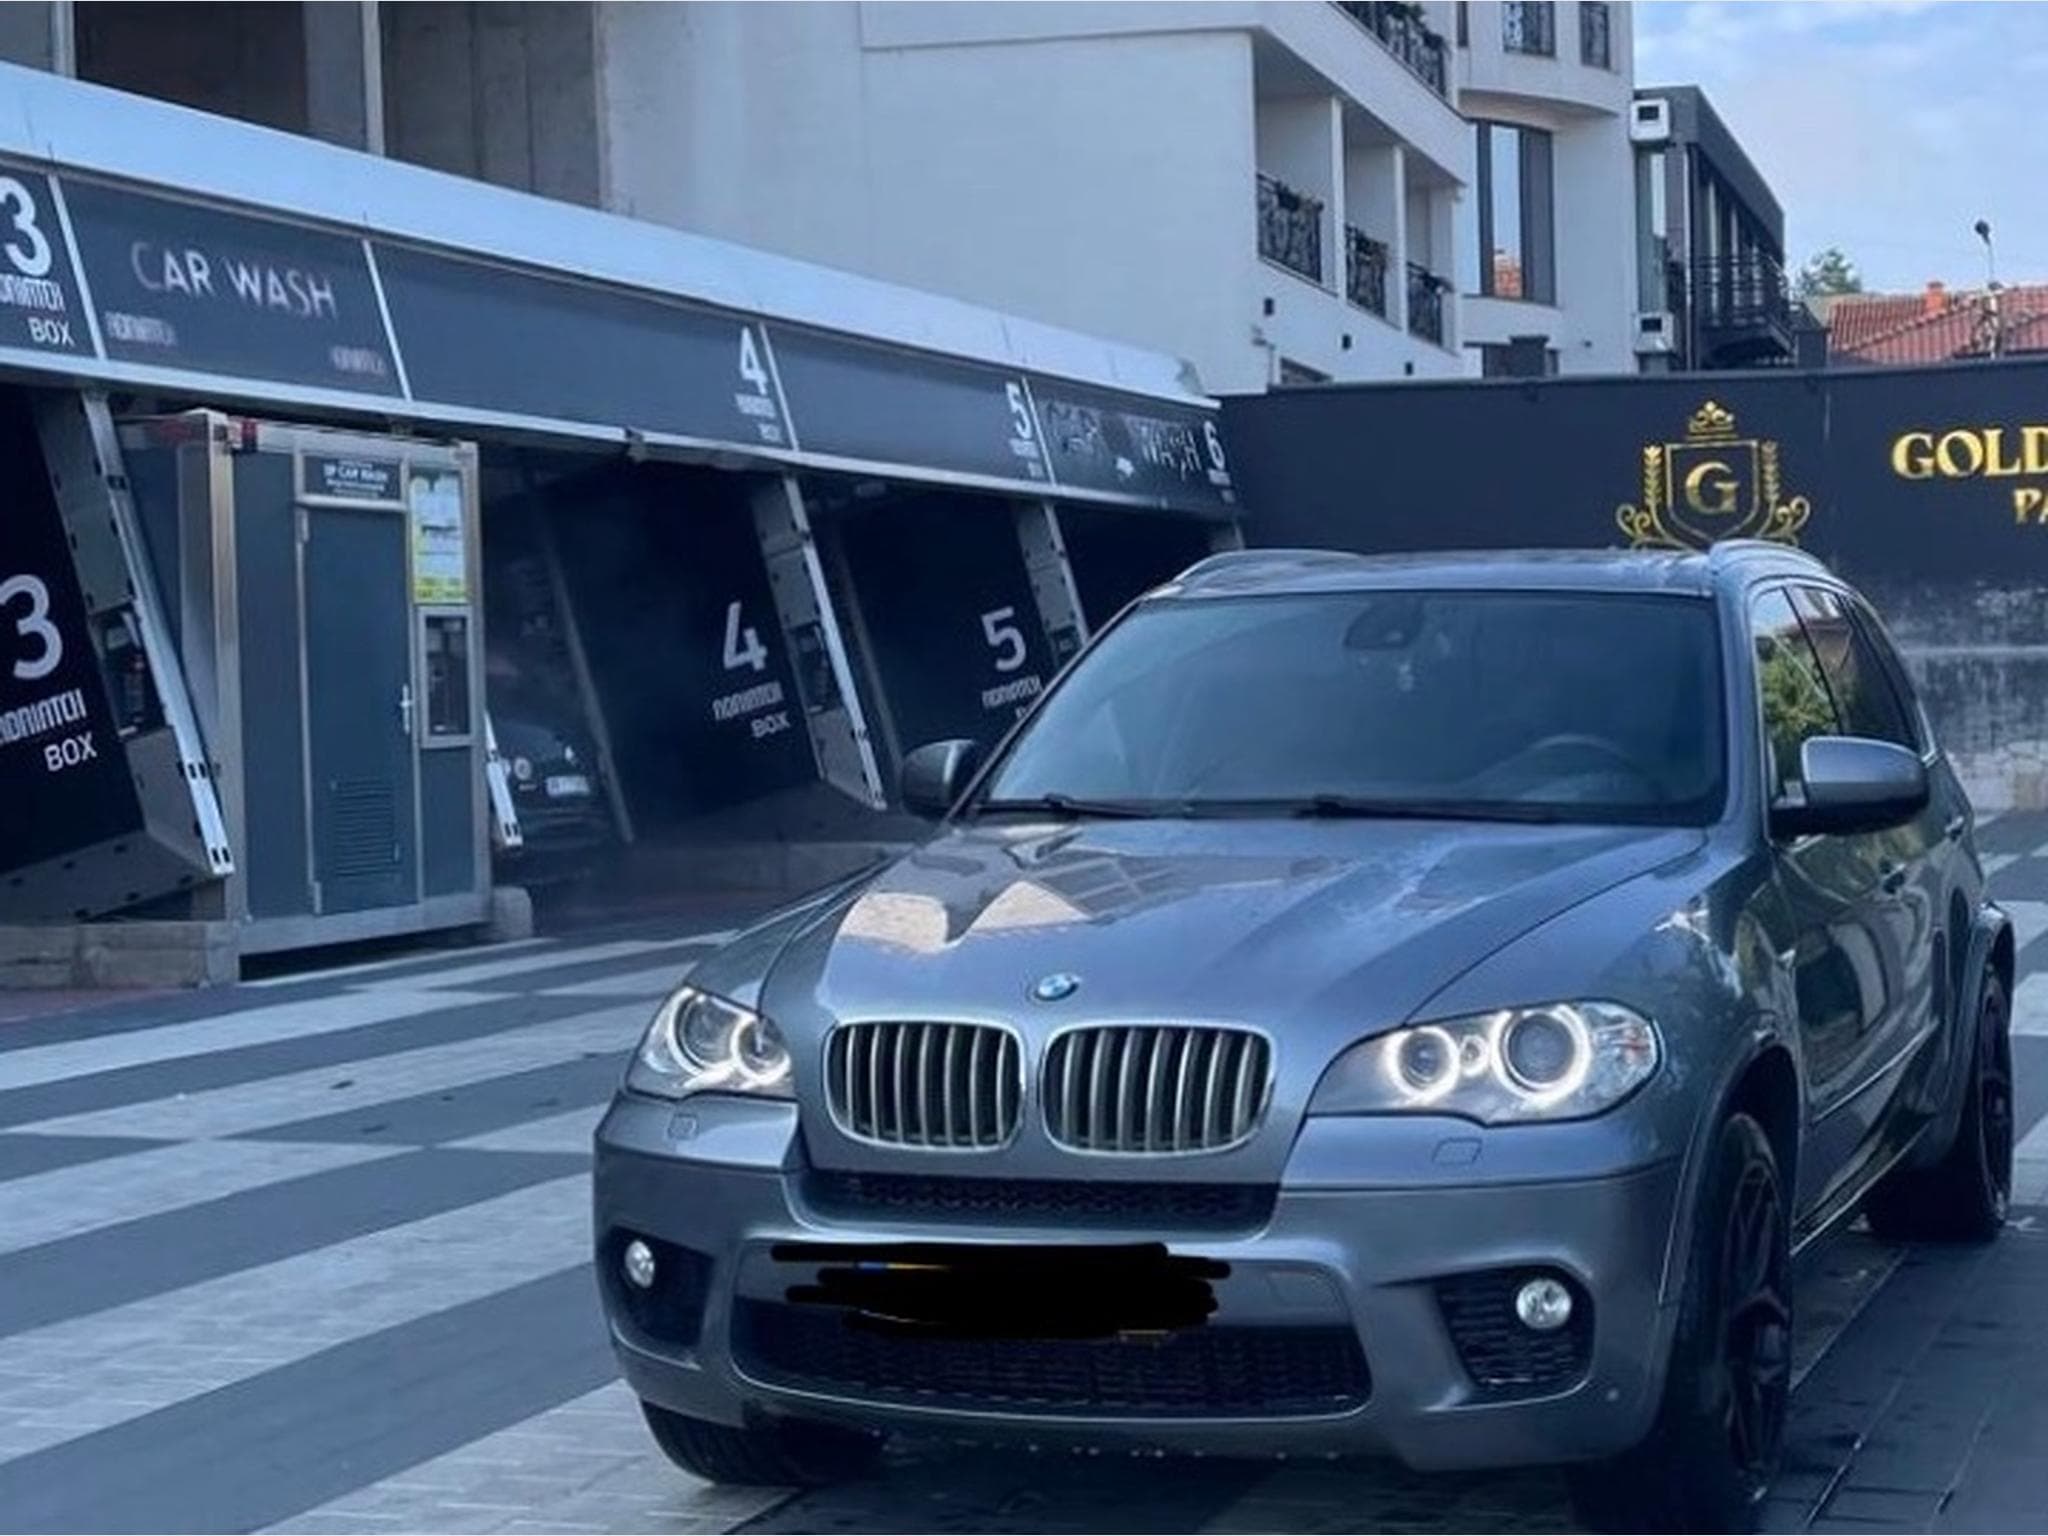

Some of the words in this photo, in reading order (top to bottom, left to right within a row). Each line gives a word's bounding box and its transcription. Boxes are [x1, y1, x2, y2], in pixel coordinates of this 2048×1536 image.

[0, 177, 52, 276] 3
[131, 241, 216, 298] CAR
[224, 257, 337, 319] WASH
[28, 316, 75, 347] BOX
[739, 326, 768, 396] 4
[1005, 381, 1032, 440] 5
[1204, 420, 1226, 470] 6
[1685, 460, 1739, 514] G
[0, 574, 63, 680] 3
[723, 601, 768, 671] 4
[981, 606, 1027, 672] 5
[44, 731, 98, 772] BOX
[750, 711, 792, 739] BOX
